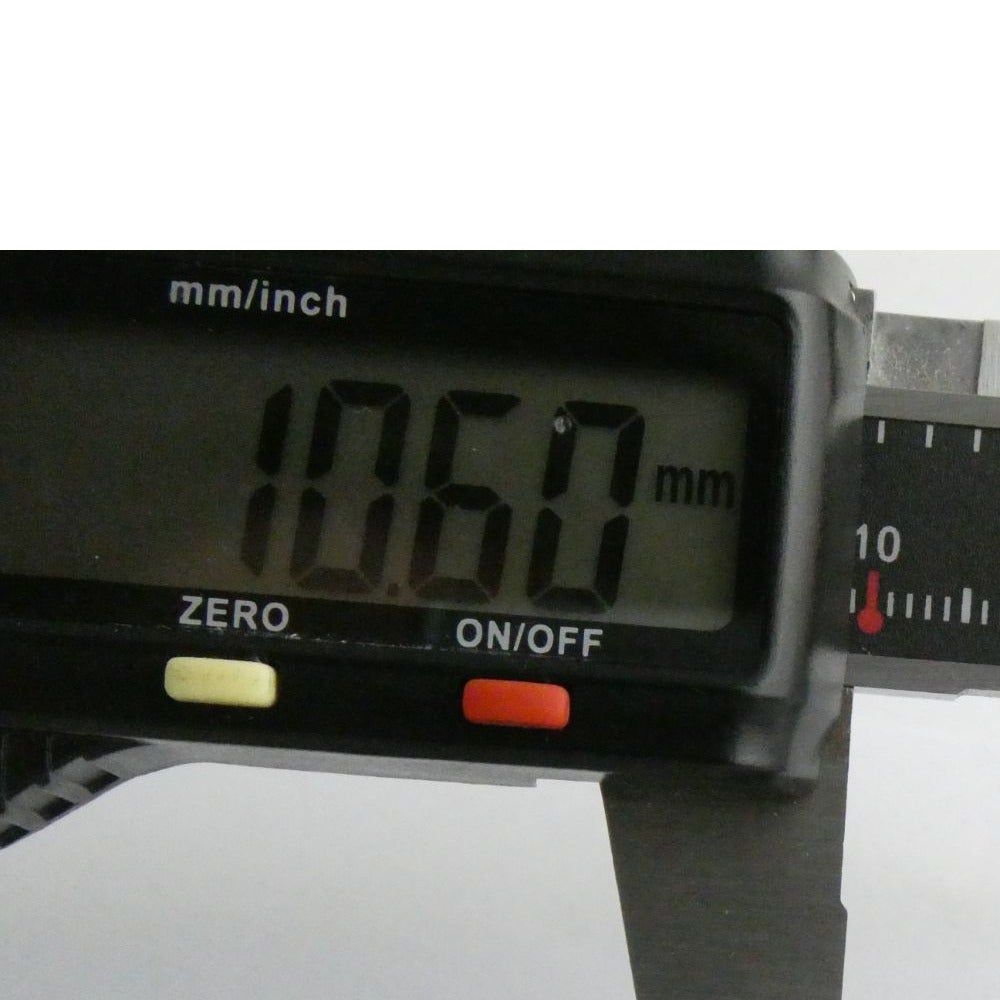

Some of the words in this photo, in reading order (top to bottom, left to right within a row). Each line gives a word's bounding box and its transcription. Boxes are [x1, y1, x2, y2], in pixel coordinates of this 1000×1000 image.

[169, 278, 348, 318] mm/inch
[655, 463, 738, 510] mm
[856, 523, 900, 563] 10
[178, 595, 290, 633] ZERO
[455, 617, 604, 658] ON/OFF
